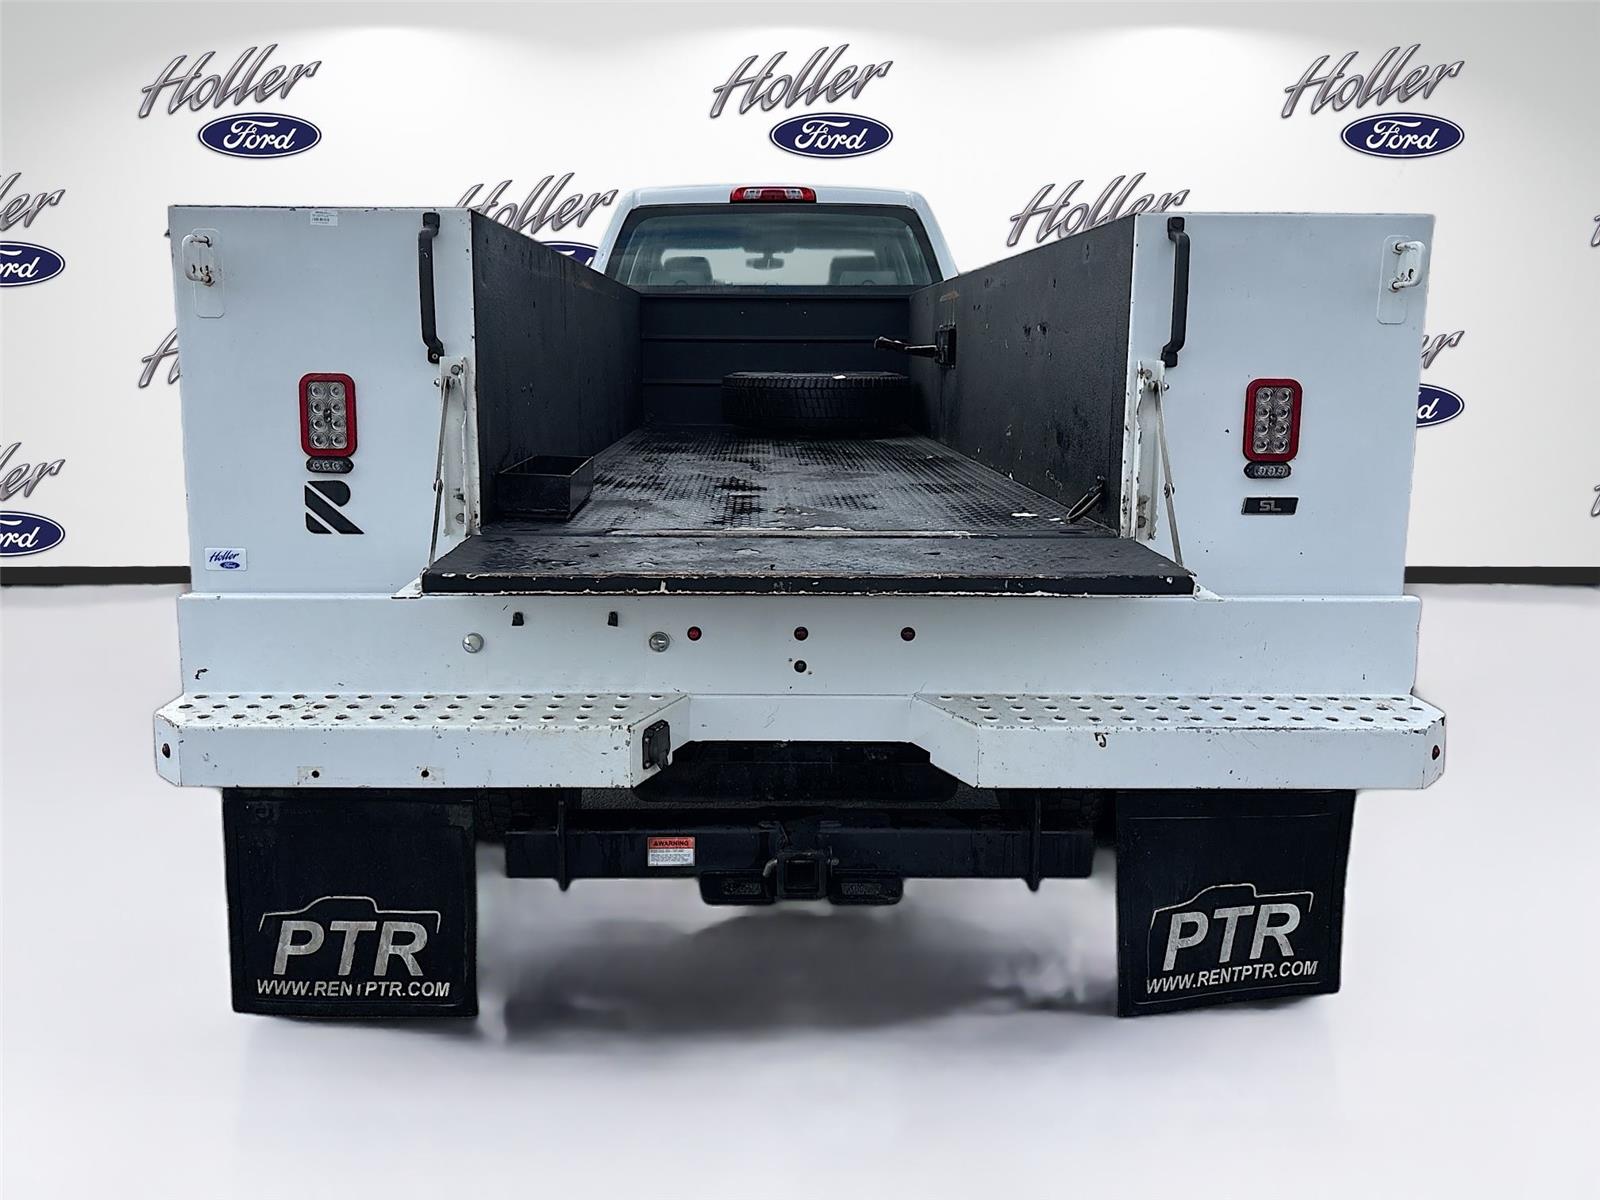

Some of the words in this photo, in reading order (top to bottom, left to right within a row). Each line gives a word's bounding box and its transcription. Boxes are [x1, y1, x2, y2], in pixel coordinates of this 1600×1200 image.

[138, 44, 322, 119] Holler
[710, 44, 893, 119] Holler
[1281, 44, 1465, 119] Holler
[223, 119, 297, 149] Ford
[794, 119, 868, 149] Ford
[1365, 119, 1439, 149] Ford
[1259, 500, 1282, 511] SL
[209, 550, 240, 562] Holler
[273, 920, 428, 976] PTR
[1162, 903, 1301, 971] PTR
[1146, 960, 1319, 994] WWW.RENTPTR.COM
